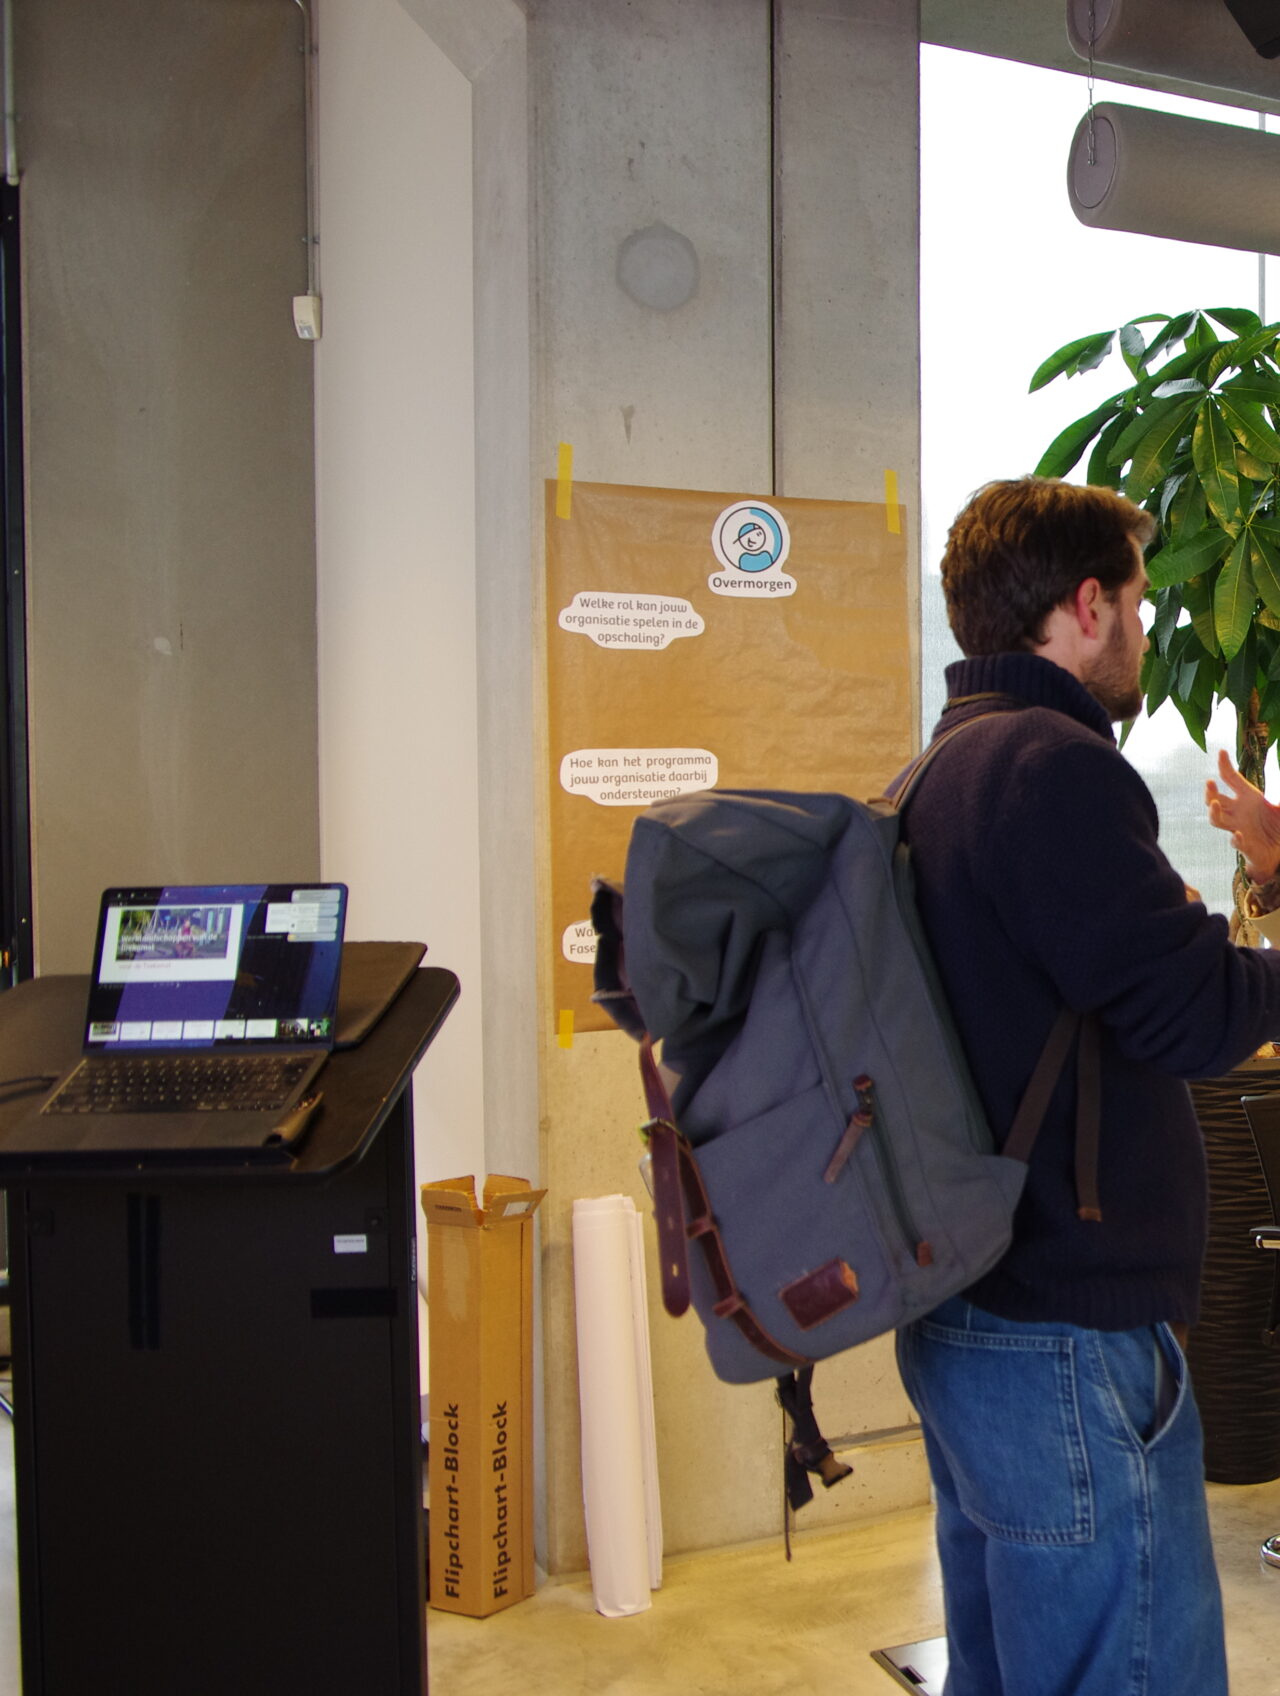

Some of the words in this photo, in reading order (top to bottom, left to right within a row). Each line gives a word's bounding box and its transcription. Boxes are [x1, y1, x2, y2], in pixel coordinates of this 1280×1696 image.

[712, 577, 792, 592] Overmorgen
[579, 597, 614, 609] Welke
[617, 599, 634, 610] rol
[637, 600, 657, 611] kan
[659, 601, 688, 614] jouw
[565, 614, 630, 627] organisatie
[633, 616, 669, 629] spelen
[672, 617, 682, 628] in
[685, 617, 698, 629] de
[597, 632, 665, 646] opschaling?
[570, 758, 593, 768] Hoe
[597, 757, 619, 767] kan
[623, 756, 641, 767] het
[646, 756, 711, 768] programma
[569, 774, 600, 787] jouw
[602, 772, 666, 786] organisatie
[668, 771, 707, 783] daarbij
[600, 787, 681, 800] ondersteunen?
[574, 927, 594, 938] Wa
[570, 944, 596, 955] Fase
[444, 1402, 463, 1599] Flipchart-Block
[492, 1400, 511, 1599] Flipchart-Block
